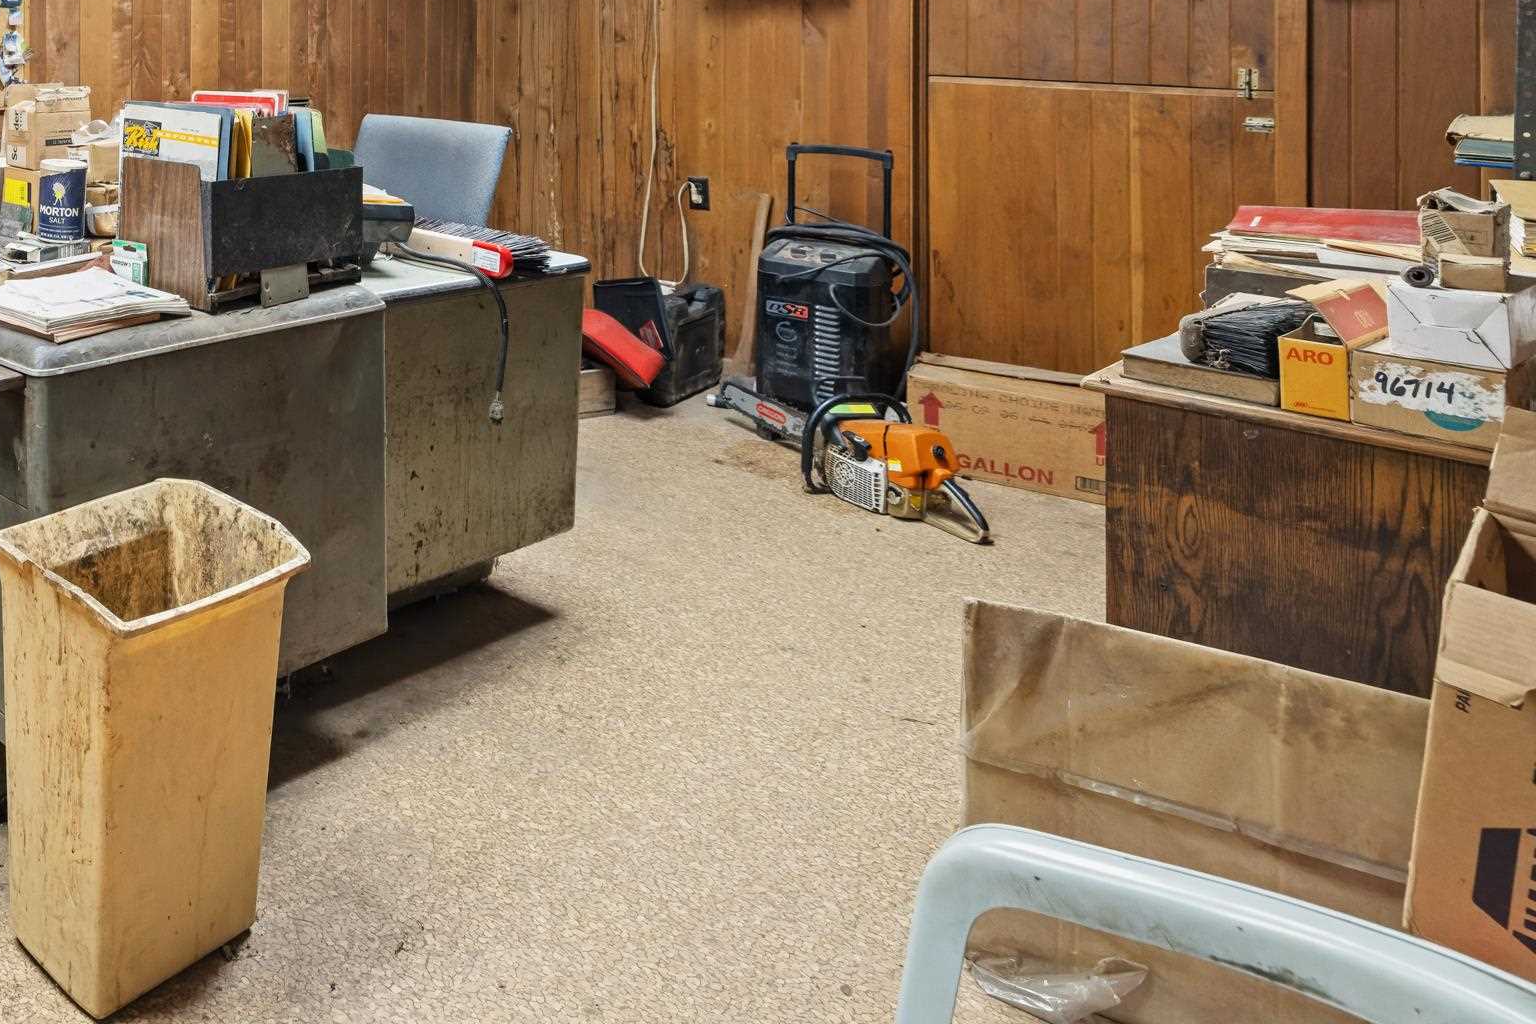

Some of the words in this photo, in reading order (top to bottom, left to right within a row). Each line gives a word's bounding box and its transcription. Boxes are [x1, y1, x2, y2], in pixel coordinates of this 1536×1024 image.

[39, 203, 79, 217] MORTON
[1286, 347, 1334, 365] ARO
[957, 452, 1055, 485] GALLON
